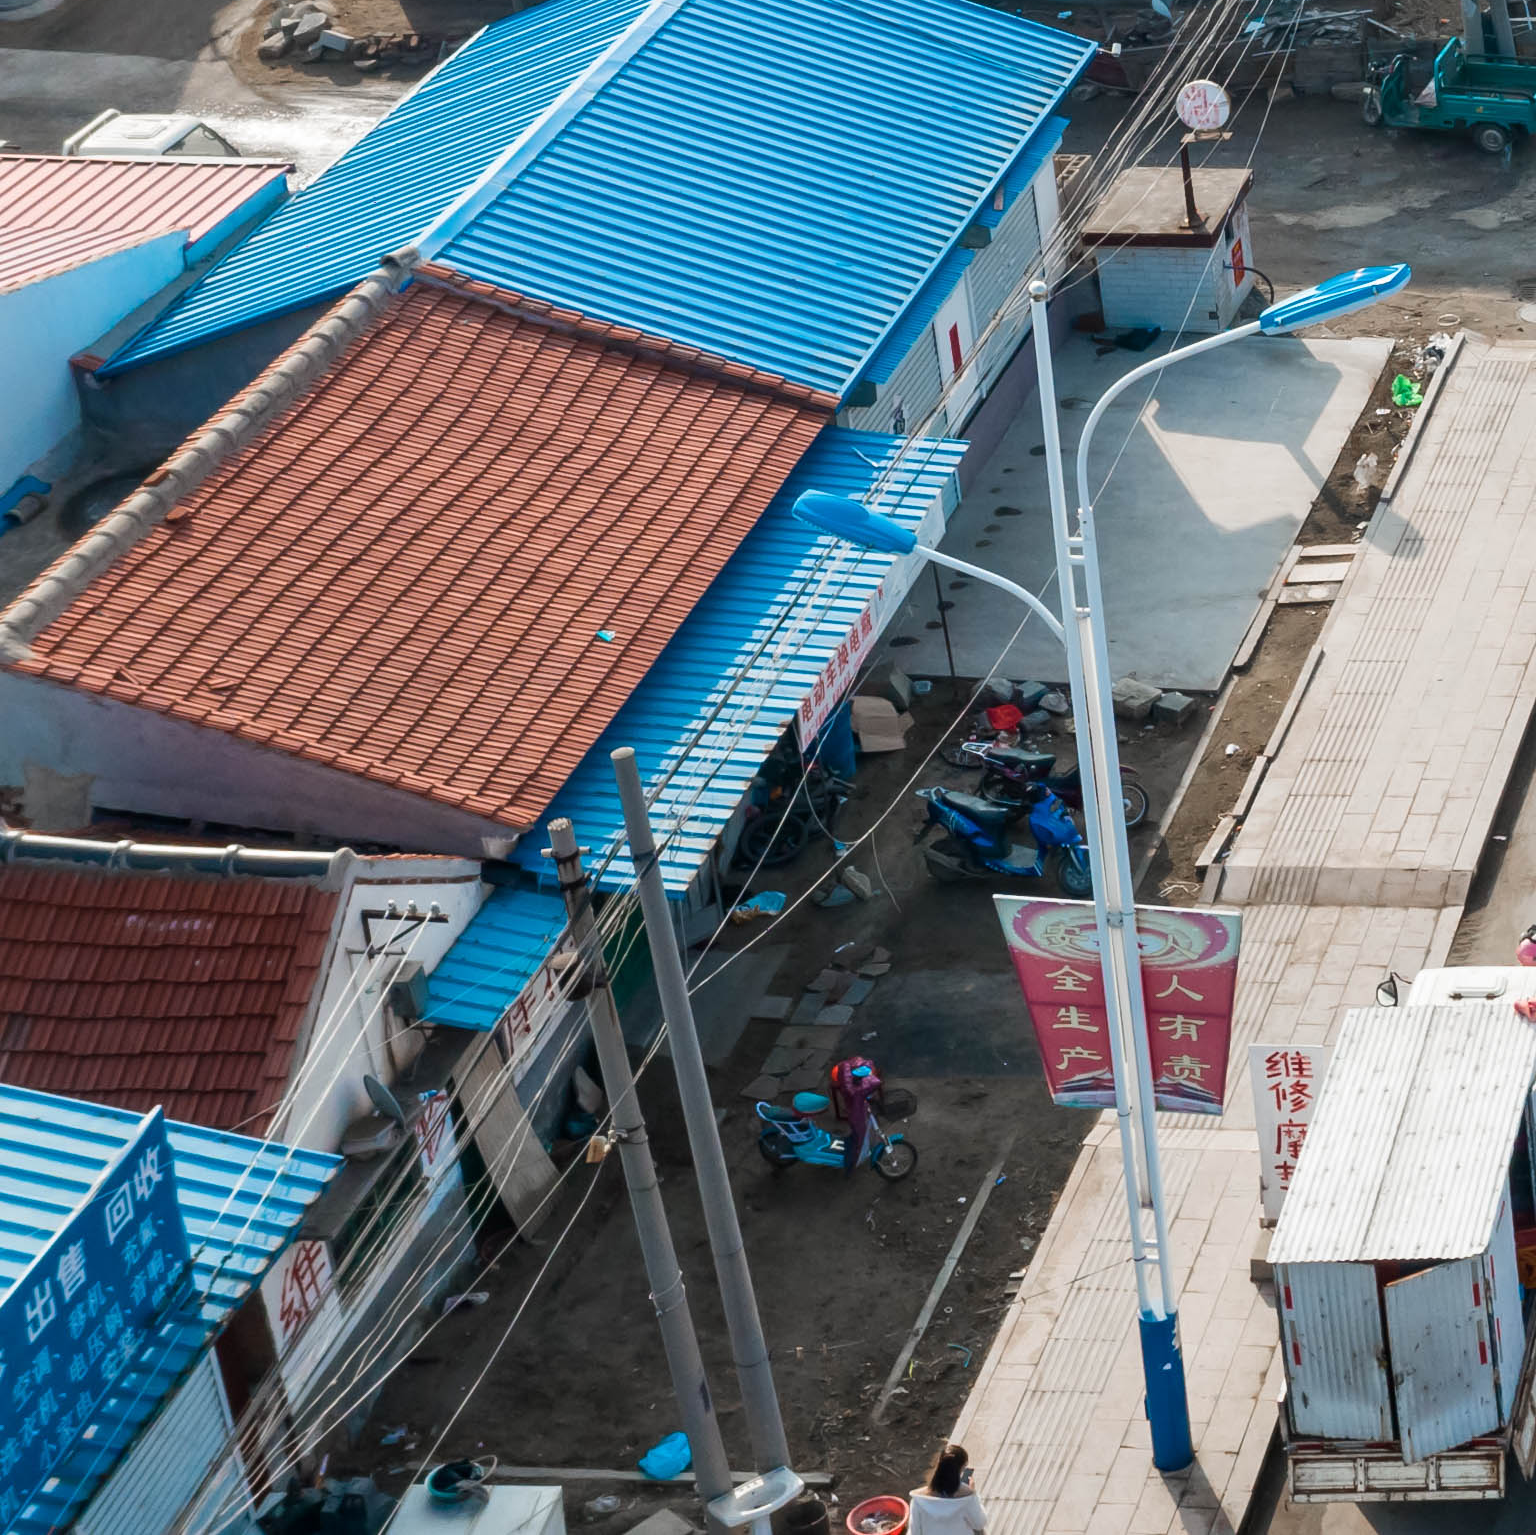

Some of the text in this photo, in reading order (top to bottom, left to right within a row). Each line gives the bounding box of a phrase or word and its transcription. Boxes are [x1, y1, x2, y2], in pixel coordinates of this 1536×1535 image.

[1040, 922, 1103, 1071] 安全生产
[1155, 932, 1212, 1082] 人人有责
[24, 1146, 163, 1343] 出售 回收
